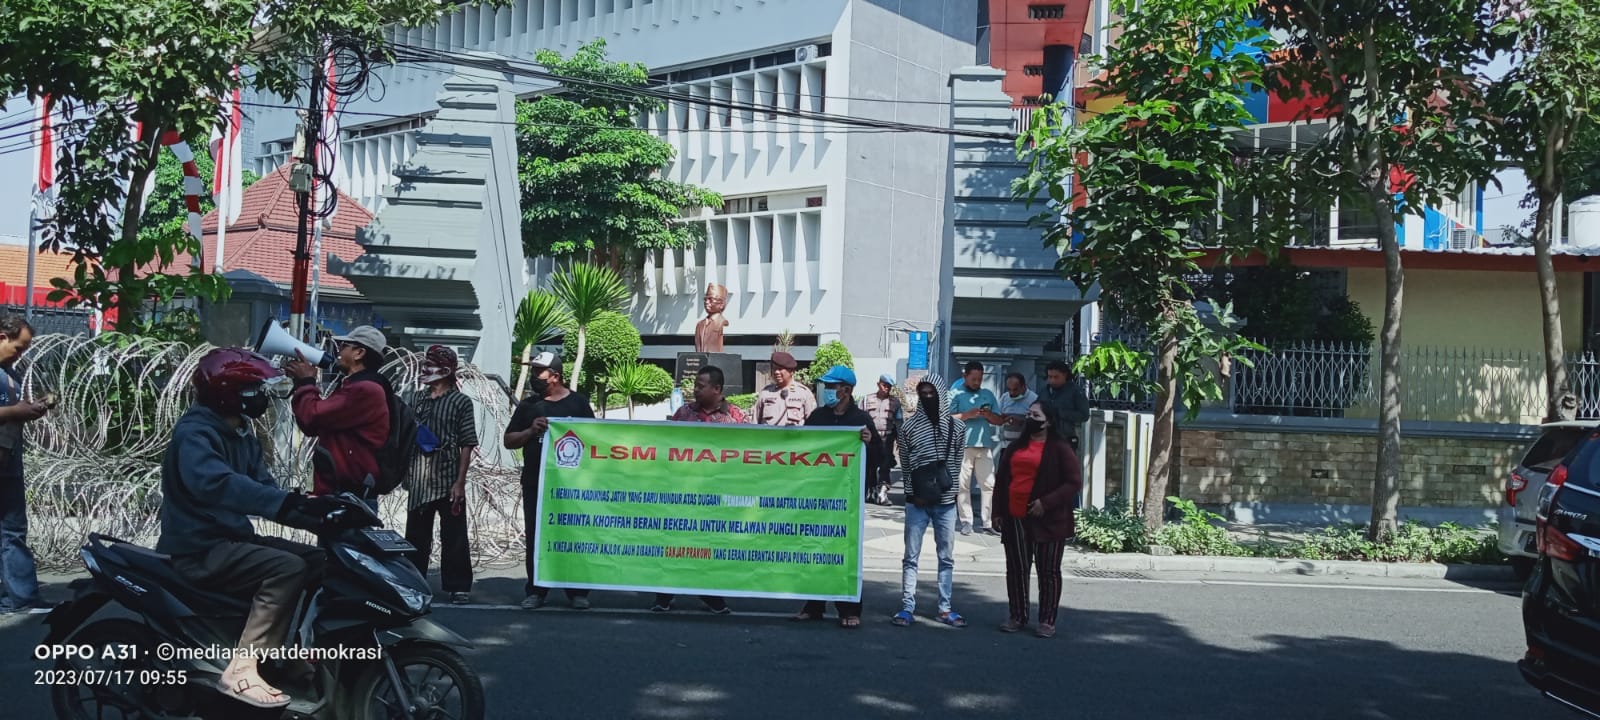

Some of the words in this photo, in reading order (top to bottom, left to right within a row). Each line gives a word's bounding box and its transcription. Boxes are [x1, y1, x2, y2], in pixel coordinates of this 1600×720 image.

[590, 445, 657, 461] LSM
[668, 447, 855, 467] MAPEKKAT
[628, 492, 643, 503] YANG
[683, 494, 697, 505] ATAS
[698, 494, 721, 506] DUGAAN
[760, 496, 776, 508] BIAYA
[776, 497, 797, 510] DAFTAR
[798, 498, 818, 510] ULANG
[818, 498, 847, 511] FANTASTIC
[548, 512, 555, 525] 2.
[557, 513, 591, 527] MEMINTA
[593, 515, 632, 529] KHOFIFAH
[633, 517, 662, 531] BERANI
[663, 518, 698, 532] BEKERJA
[700, 520, 726, 533] UNTUK
[728, 521, 767, 535] MELAWAN
[768, 522, 798, 536] PUNGLI
[799, 523, 847, 538] PENDIDIKAN
[713, 548, 727, 560] YANG
[727, 549, 747, 561] BERANI
[365, 600, 391, 615] HONDA
